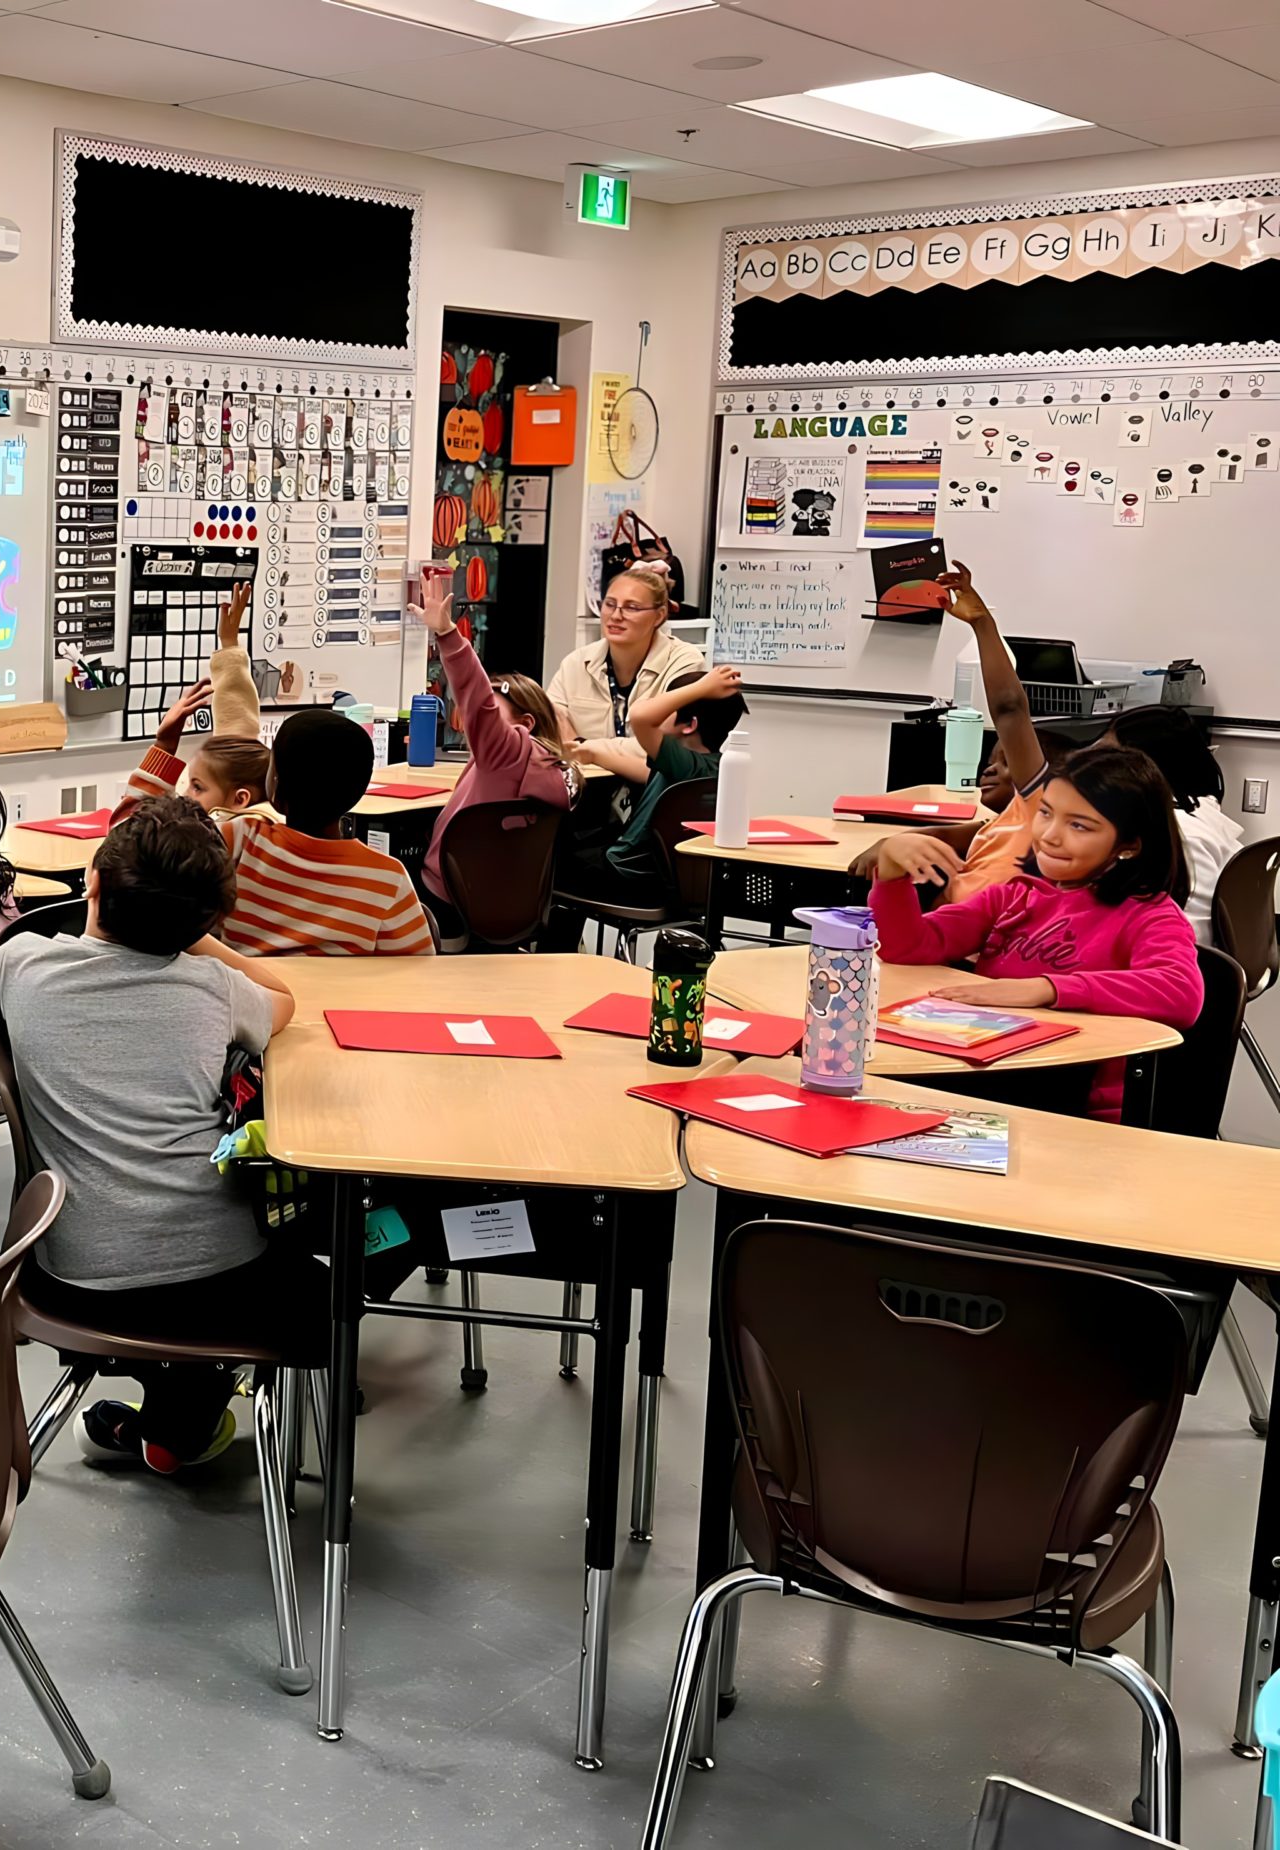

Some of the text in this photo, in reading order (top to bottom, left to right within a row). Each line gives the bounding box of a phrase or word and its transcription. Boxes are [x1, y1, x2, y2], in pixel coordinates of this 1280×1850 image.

[741, 260, 776, 280] Aa
[787, 253, 818, 275] Bb
[828, 251, 867, 273] Cc
[876, 244, 915, 269] Dd
[928, 243, 960, 265] Ee
[985, 238, 1006, 260] Ff
[1024, 233, 1071, 260] Gg
[1084, 228, 1119, 252] Hh
[1148, 223, 1166, 247] Ii
[1202, 218, 1226, 245] Jj
[42, 353, 52, 366] 39
[28, 392, 48, 410] 2024
[723, 395, 735, 404] 60
[836, 390, 849, 402] 65
[860, 389, 872, 400] 66
[885, 388, 898, 399] 67
[909, 388, 922, 399] 68
[936, 386, 948, 398] 69
[963, 385, 974, 397] 70
[991, 384, 1000, 396] 71
[1043, 383, 1056, 394] 73
[1101, 380, 1114, 392] 75
[1129, 379, 1142, 390] 76
[1160, 377, 1173, 389] 77
[1189, 377, 1203, 389] 78
[1220, 376, 1233, 388] 79
[1248, 375, 1264, 387] 80
[753, 414, 907, 438] LANGUAGE
[1048, 401, 1213, 432] Vowel Valley
